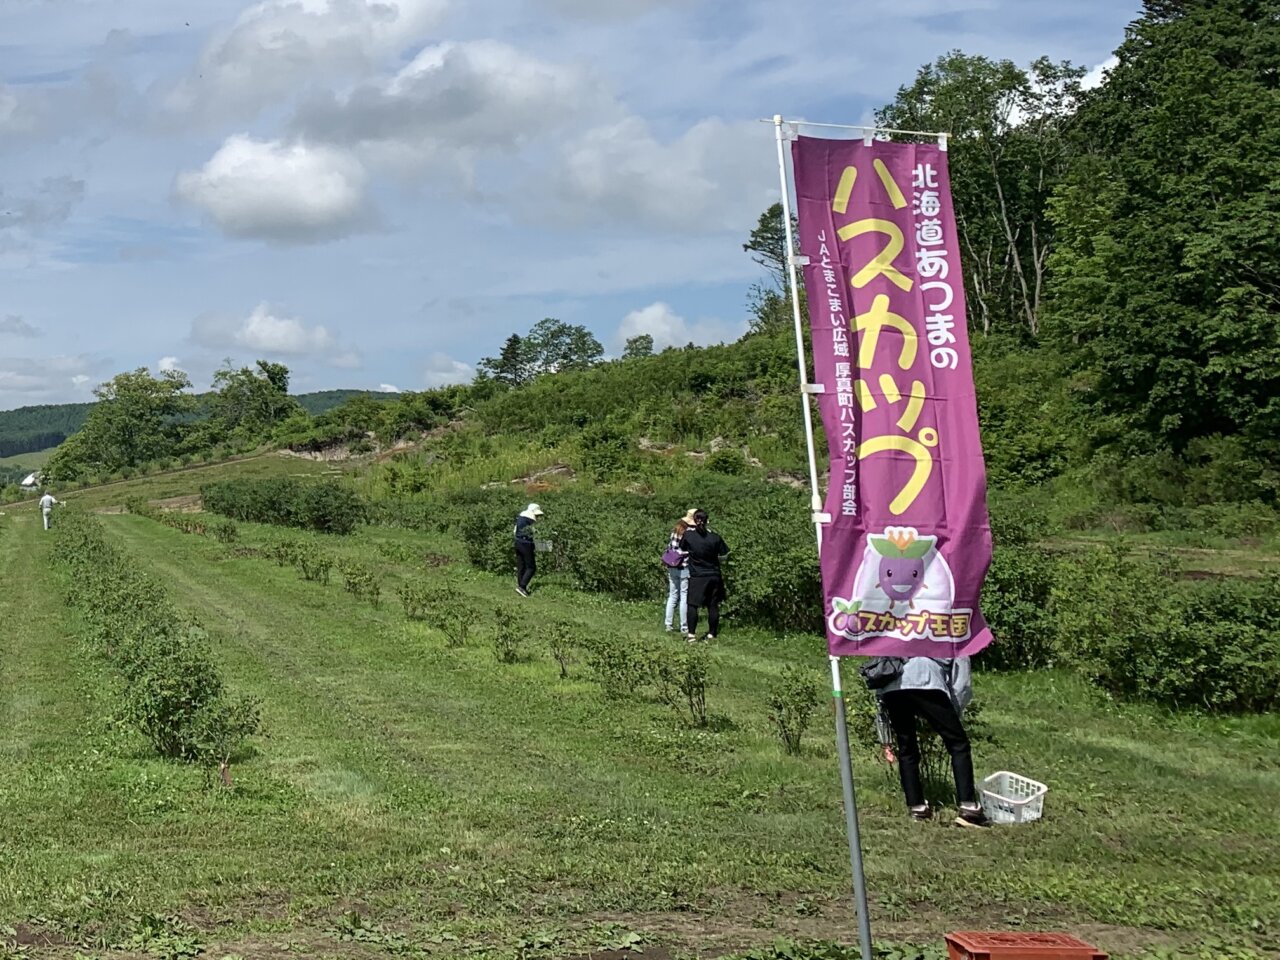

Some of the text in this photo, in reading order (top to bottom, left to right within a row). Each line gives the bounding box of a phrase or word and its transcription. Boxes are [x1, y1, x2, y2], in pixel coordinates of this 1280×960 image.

[817, 229, 850, 357] JAとまこまい広域
[831, 158, 939, 516] ハスカップ
[912, 163, 959, 370] 北海道あつまの
